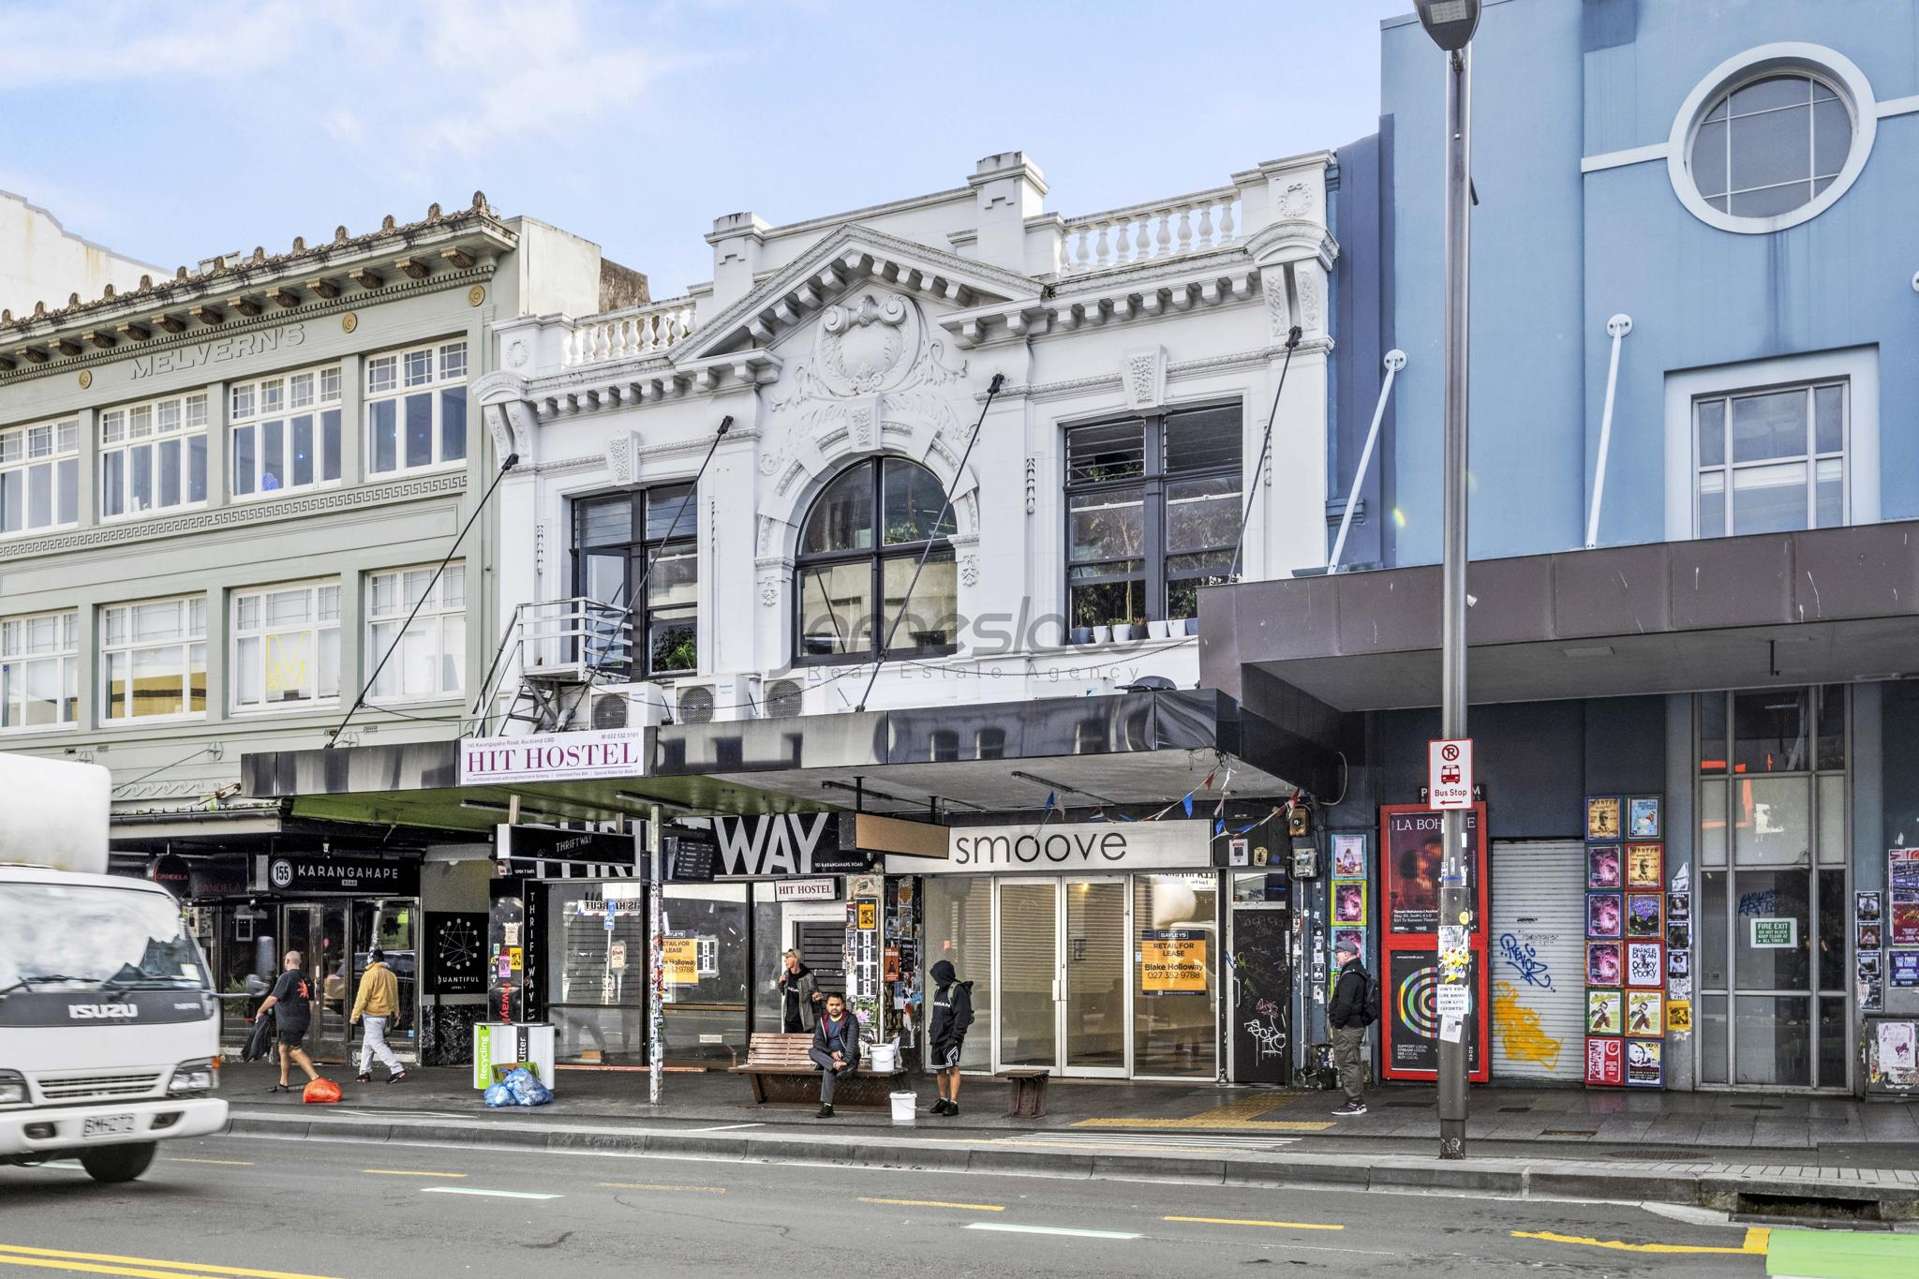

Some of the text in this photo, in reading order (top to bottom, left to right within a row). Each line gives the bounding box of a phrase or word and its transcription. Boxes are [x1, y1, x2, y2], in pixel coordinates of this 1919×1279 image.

[130, 323, 305, 380] MELVERN'S
[466, 743, 639, 772] HIT HOSTEL
[1434, 789, 1448, 797] Bus
[1449, 788, 1467, 797] Stop
[1397, 819, 1412, 831] LA
[556, 834, 593, 852] THRIFTWAY
[713, 812, 829, 875] WAY
[956, 832, 1127, 864] smoove
[276, 865, 399, 881] 155 KARANGAHAPE
[779, 884, 833, 894] HIT HOSTEL
[1162, 949, 1185, 957] LEASE
[1144, 963, 1203, 972] Blake Holloway
[68, 1003, 138, 1019] ISUZU
[480, 1036, 489, 1080] Recycling
[518, 1037, 527, 1062] Litter
